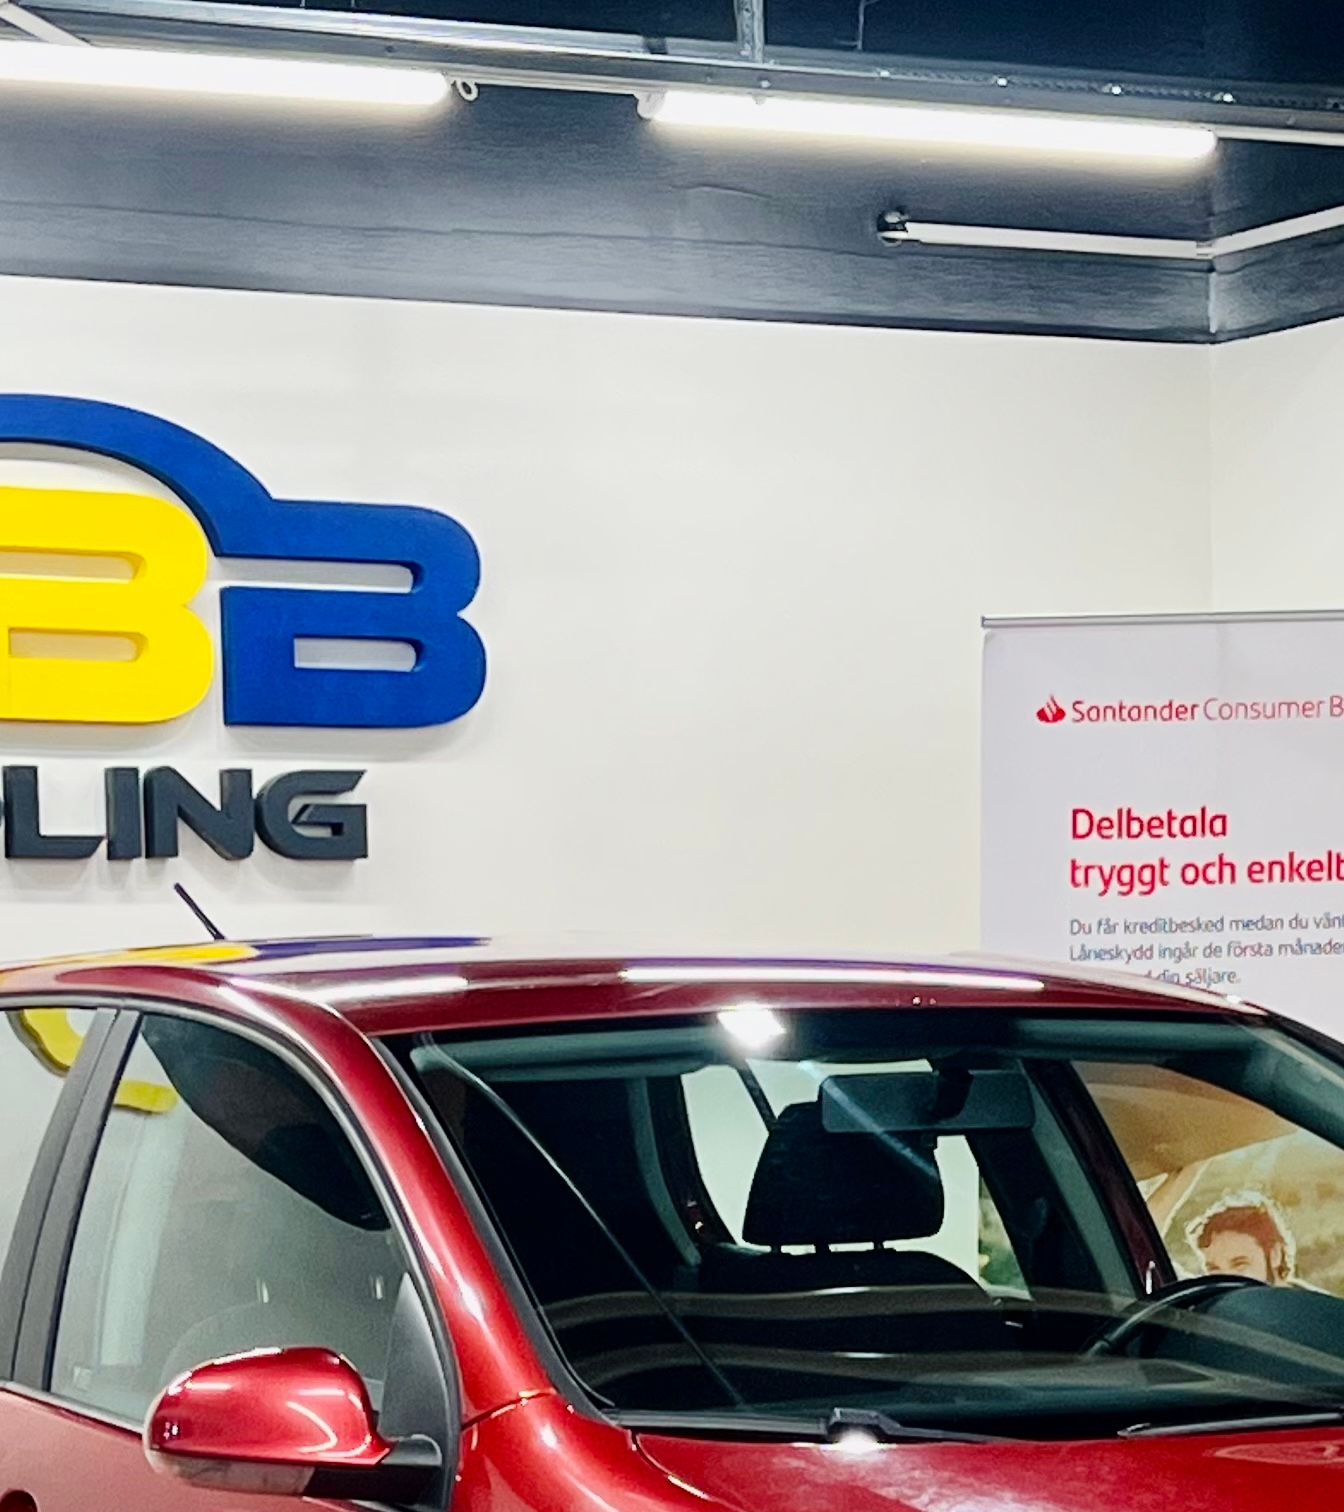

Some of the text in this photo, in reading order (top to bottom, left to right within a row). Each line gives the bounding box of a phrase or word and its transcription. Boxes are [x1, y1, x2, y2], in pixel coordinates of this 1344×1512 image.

[1071, 698, 1200, 724] Santander
[1203, 697, 1325, 721] Consumer
[1070, 805, 1229, 840] Delbetala
[1069, 857, 1170, 897] tryggt
[1179, 852, 1237, 886] och
[1069, 918, 1092, 936] Du
[1097, 917, 1119, 935] får
[1123, 916, 1224, 934] kreditbesked
[1229, 914, 1285, 931] medan
[1288, 913, 1309, 930] du
[1069, 944, 1154, 965] Låneskydd
[1158, 943, 1199, 963] ingår
[1202, 941, 1223, 958] de
[1226, 940, 1274, 958] första
